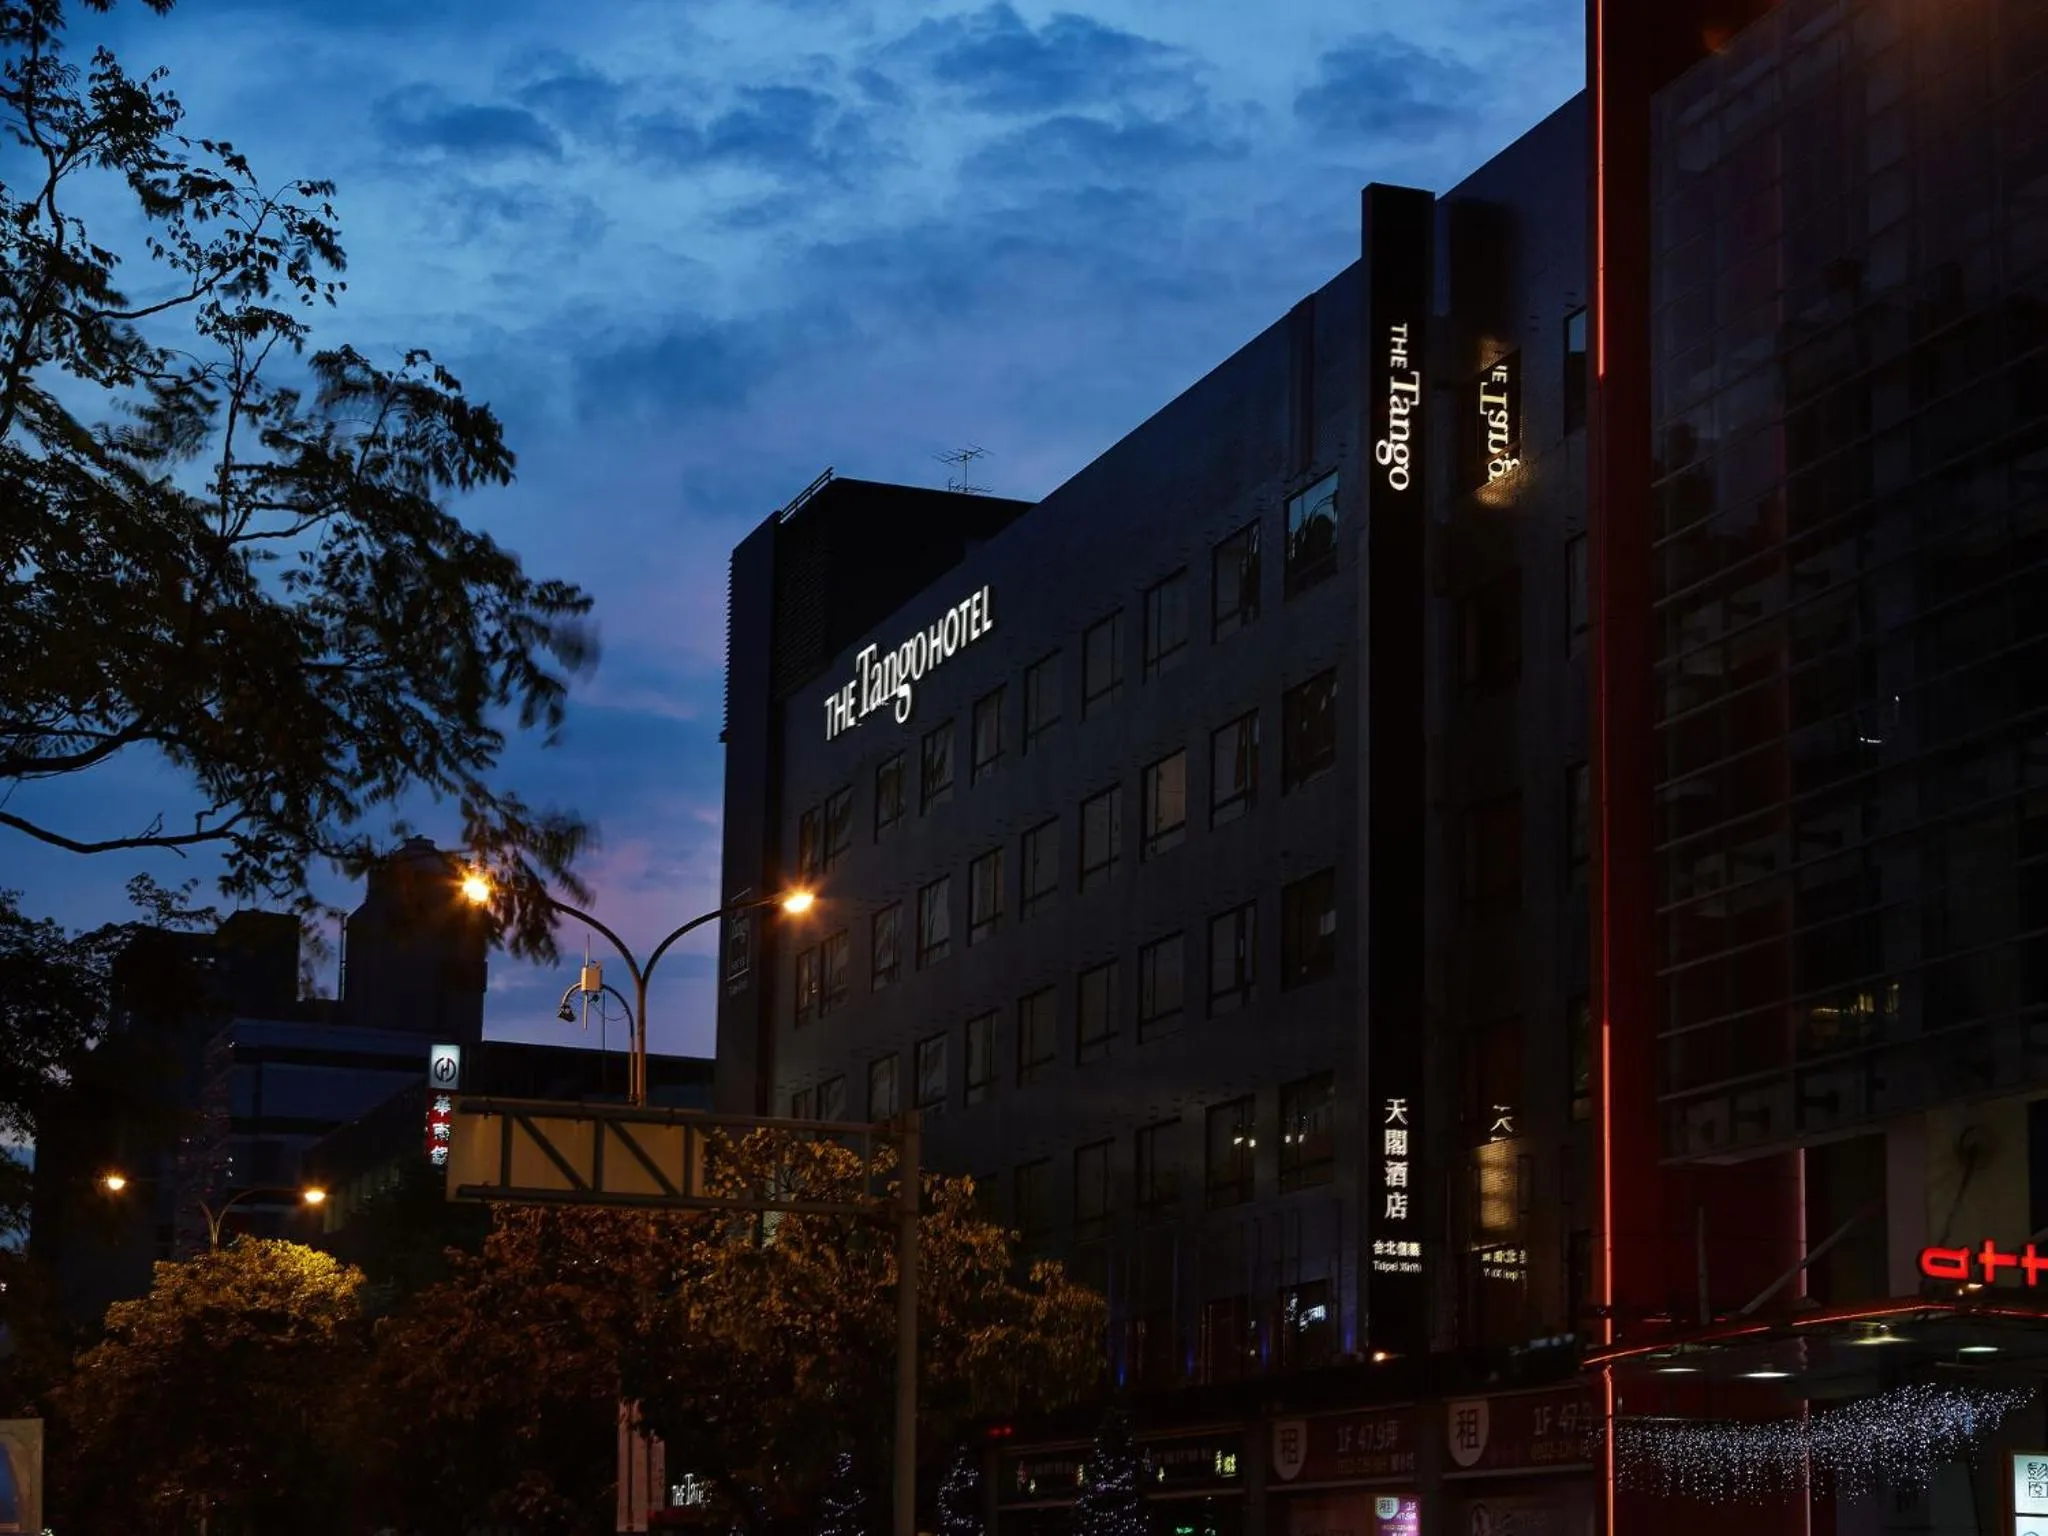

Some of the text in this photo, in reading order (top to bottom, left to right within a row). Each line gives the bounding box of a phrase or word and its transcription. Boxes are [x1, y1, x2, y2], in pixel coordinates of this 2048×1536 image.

[1376, 322, 1420, 491] THE Tango
[824, 585, 993, 741] THE Tango HOTEL
[1385, 1098, 1408, 1220] 天閣酒店
